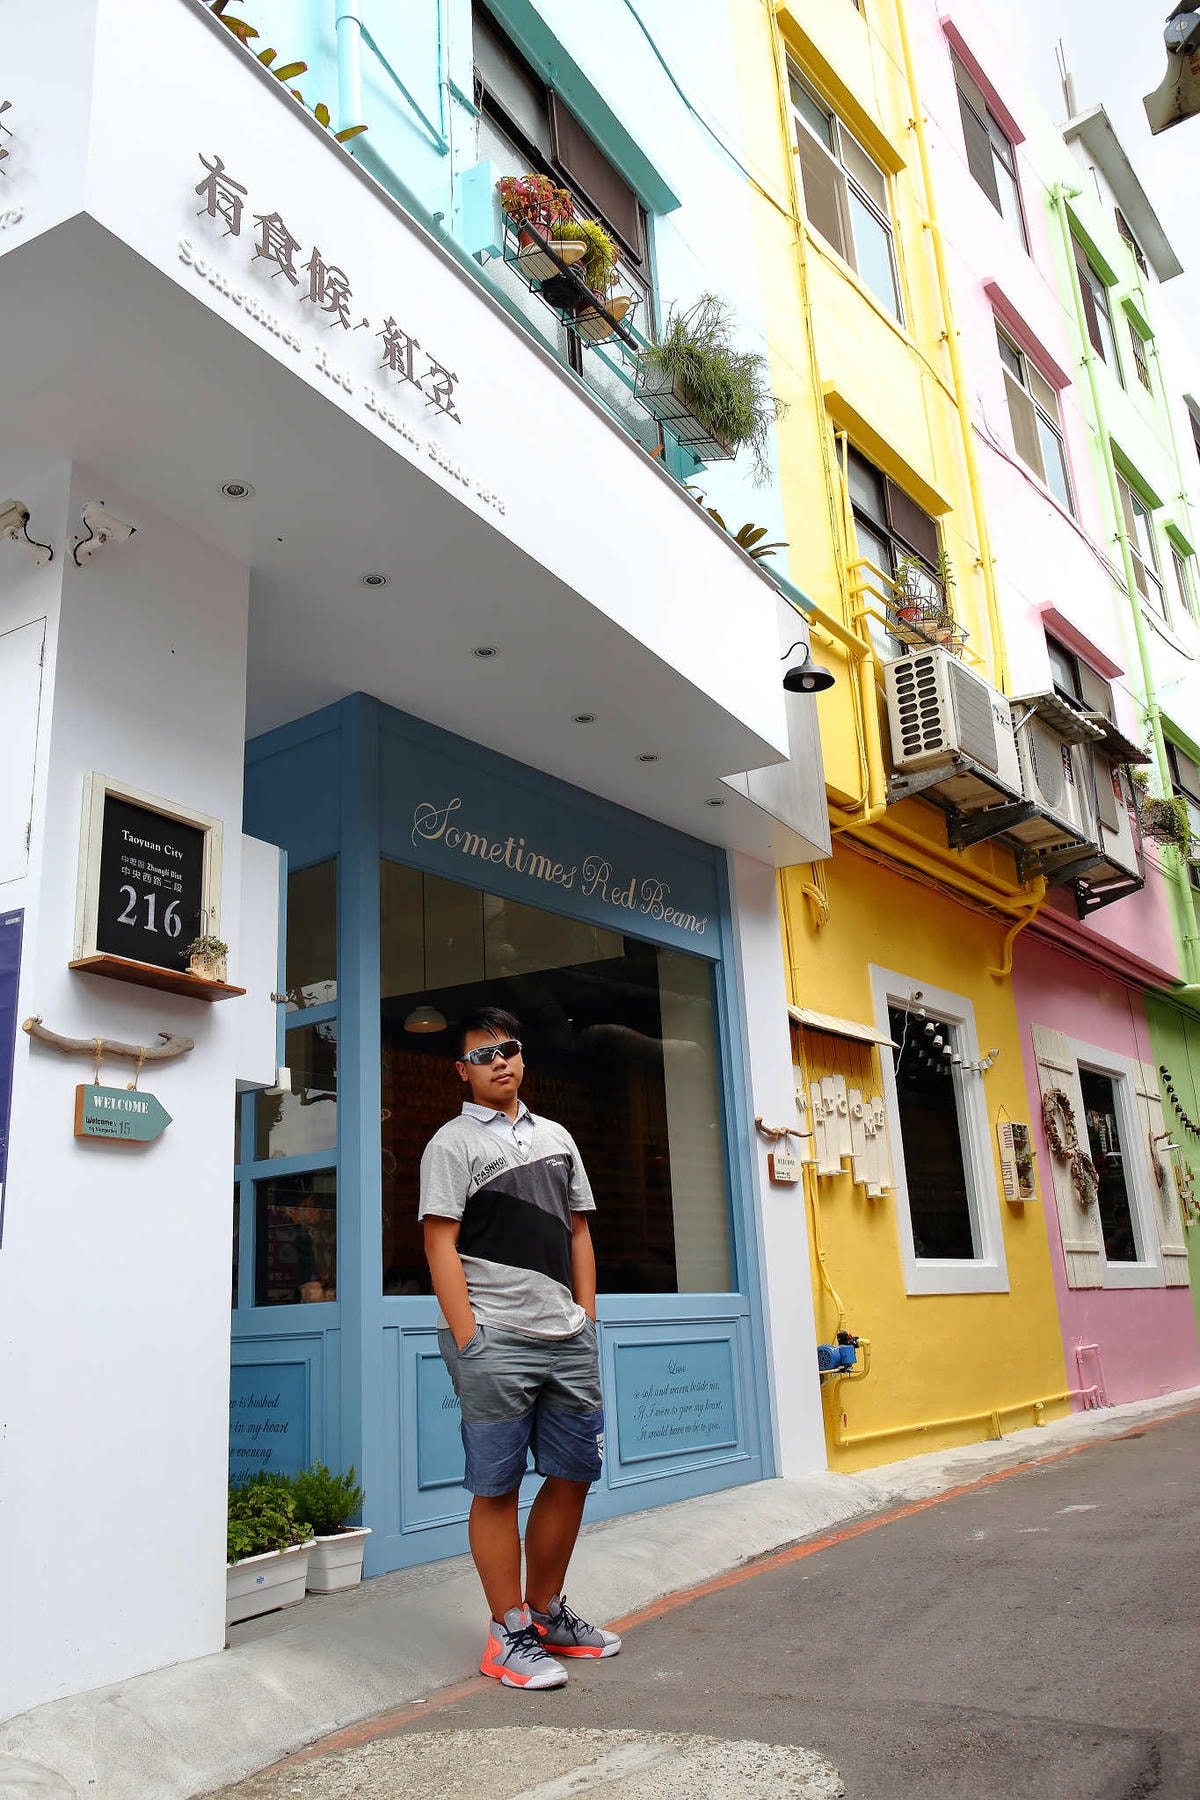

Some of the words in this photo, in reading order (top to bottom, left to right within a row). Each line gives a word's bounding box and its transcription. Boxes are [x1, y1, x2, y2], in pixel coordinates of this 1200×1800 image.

[178, 238, 303, 353] Sometimes
[313, 343, 354, 396] Red
[426, 439, 470, 487] Since
[121, 829, 161, 853] Taoyuan
[164, 844, 184, 861] City
[147, 862, 170, 877] Zhongli
[411, 797, 578, 889] Sometimes
[581, 855, 637, 910] Red
[640, 878, 708, 936] Beans
[117, 884, 182, 938] 216
[93, 1095, 149, 1114] WELCOME
[247, 1392, 280, 1409] hushed
[234, 1420, 244, 1433] in
[246, 1423, 261, 1441] my
[262, 1418, 289, 1434] heart
[236, 1447, 273, 1466] evening
